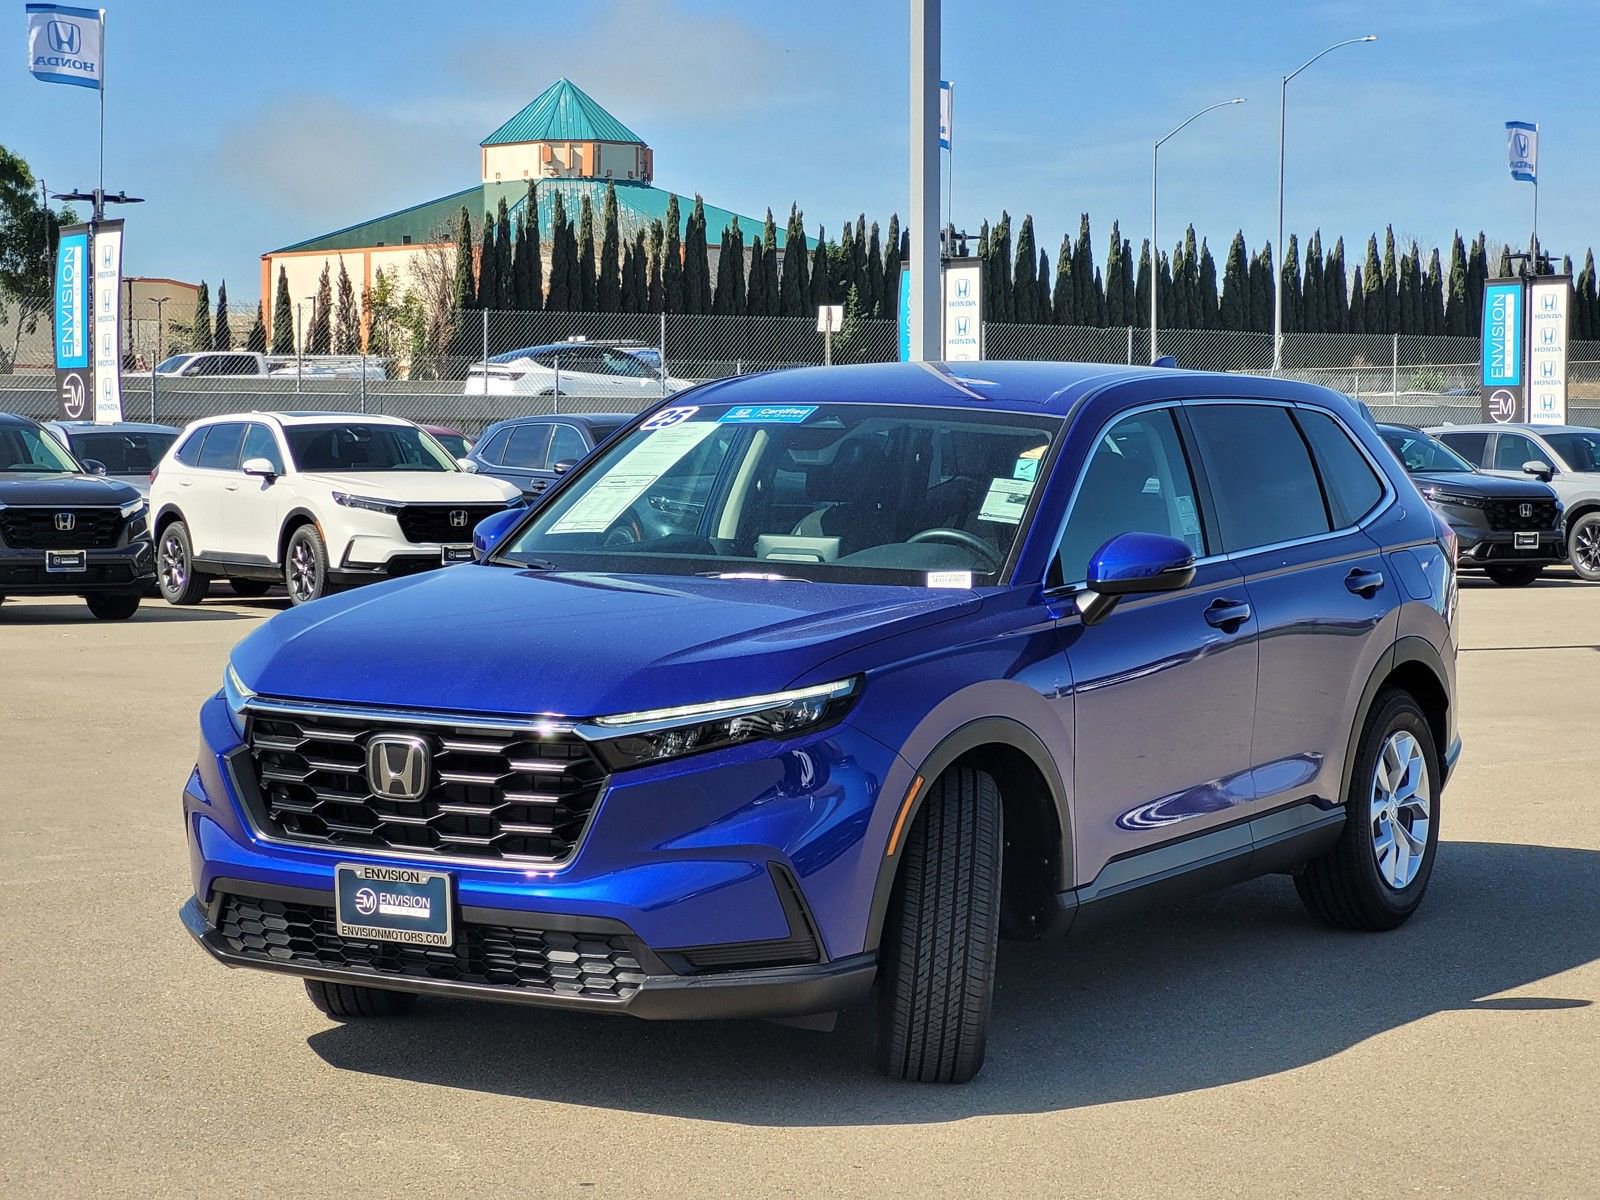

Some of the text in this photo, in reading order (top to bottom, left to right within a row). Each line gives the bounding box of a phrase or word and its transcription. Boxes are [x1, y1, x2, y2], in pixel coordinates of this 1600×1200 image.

[62, 246, 74, 357] ENVISION
[1491, 293, 1505, 378] ENVISION
[97, 403, 119, 412] HONDA
[645, 409, 693, 427] 25
[364, 867, 420, 883] ENVISION
[379, 892, 431, 909] ENVISION
[341, 925, 448, 945] ENVISIONMOTORS.COM
